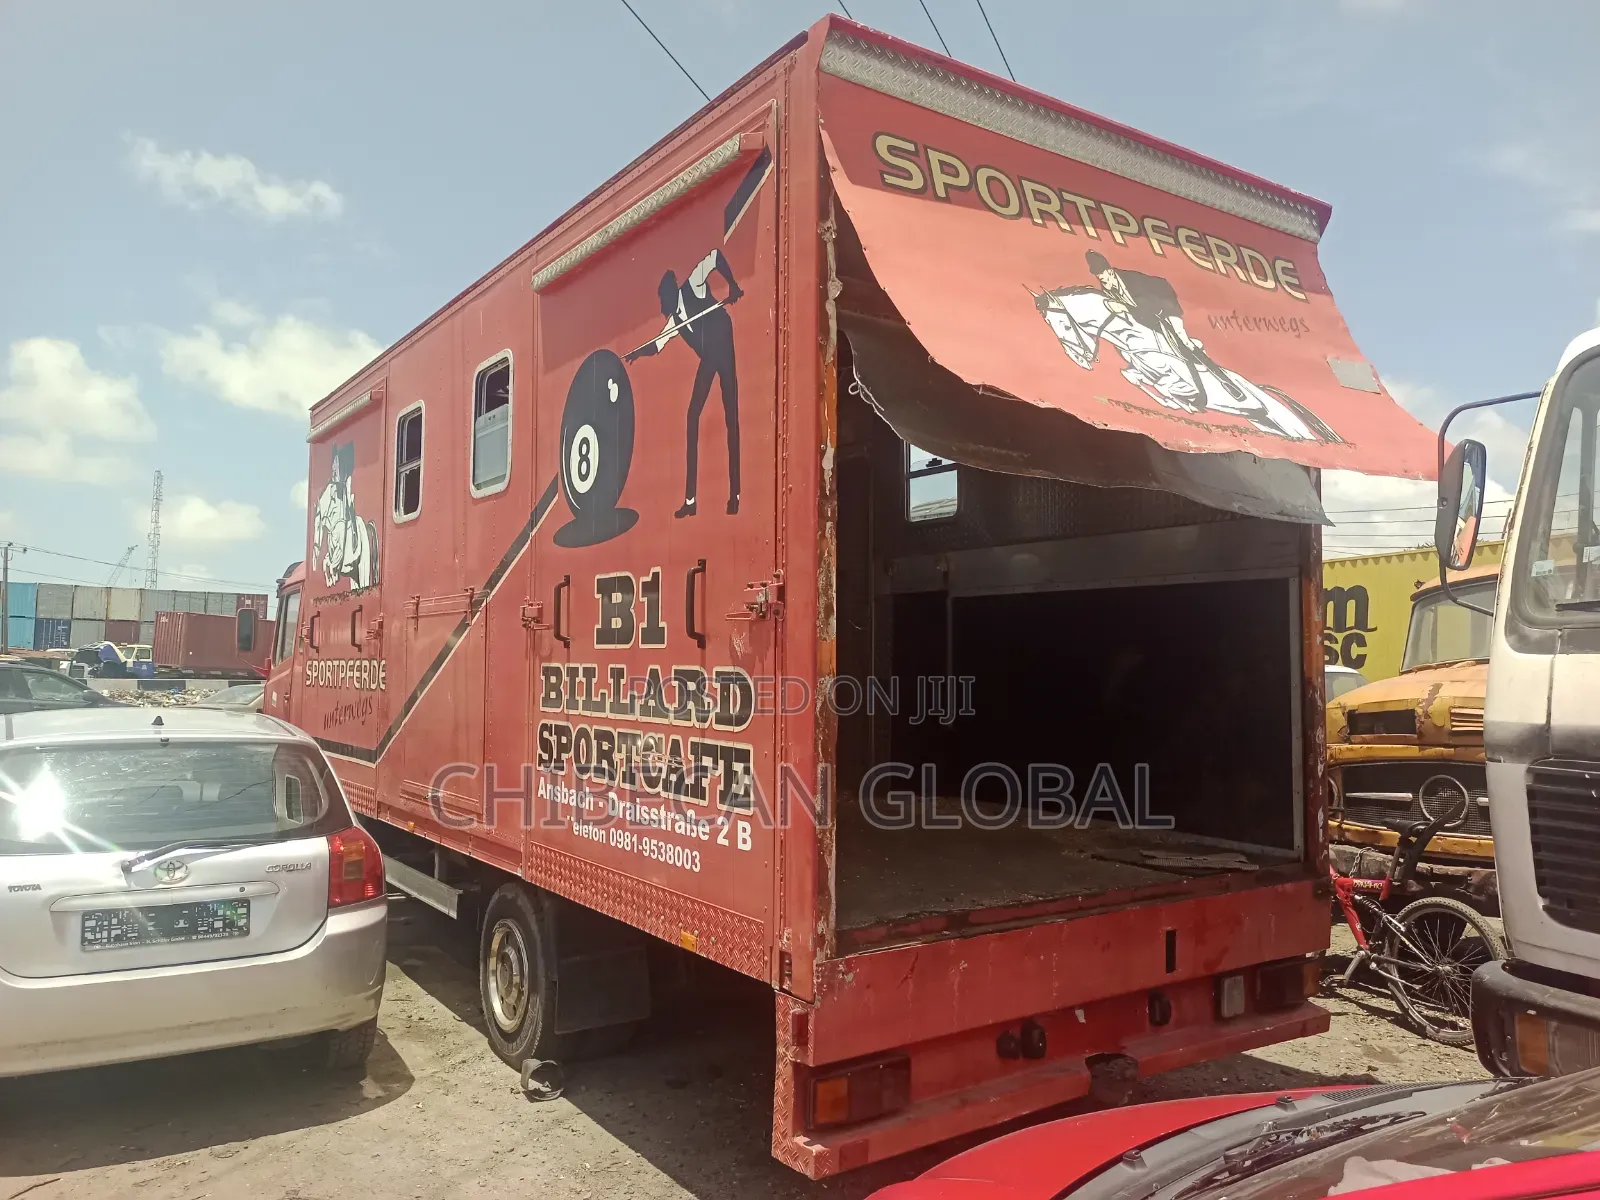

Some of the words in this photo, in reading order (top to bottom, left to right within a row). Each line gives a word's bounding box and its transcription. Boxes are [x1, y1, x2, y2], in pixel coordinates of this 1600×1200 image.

[872, 131, 1309, 303] SPORTPFERDE
[1207, 310, 1310, 338] unterwegs
[578, 436, 591, 483] 8
[594, 566, 667, 649] B1
[305, 658, 386, 691] SPORTPFERDE
[540, 662, 755, 732] BILLARD
[323, 695, 373, 731] unterwegs
[537, 776, 594, 811] Ansbach
[608, 792, 710, 841] Draisstraße
[716, 816, 729, 846] 2
[737, 820, 752, 851] B
[265, 862, 312, 873] COROLLA
[567, 815, 606, 843] elefon
[609, 827, 701, 873] 0981-9538003
[7, 883, 42, 893] TOYOTA
